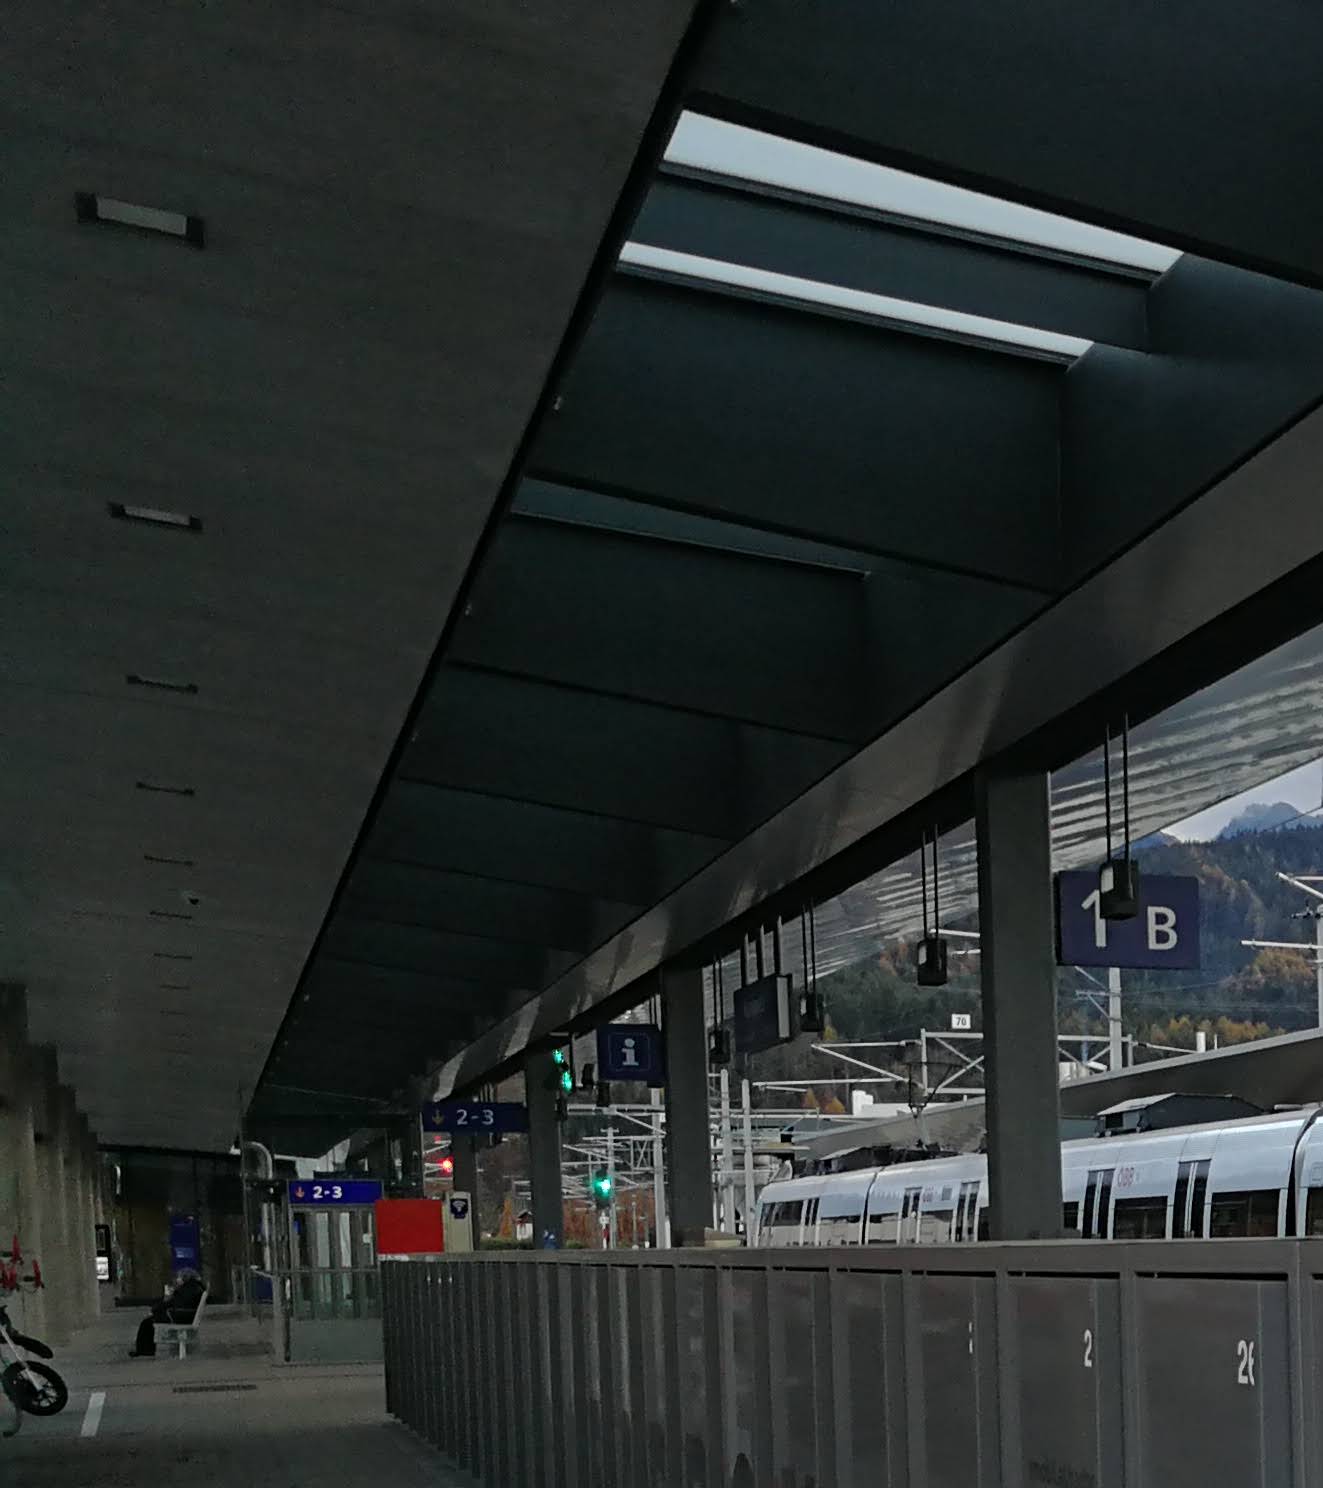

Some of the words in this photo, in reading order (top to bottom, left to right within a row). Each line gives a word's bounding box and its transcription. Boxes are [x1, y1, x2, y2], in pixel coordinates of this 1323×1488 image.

[1081, 889, 1106, 947] 1
[1147, 906, 1178, 950] B
[456, 1108, 495, 1126] 2-3
[312, 1185, 343, 1199] 2-3
[1084, 1329, 1093, 1367] 2
